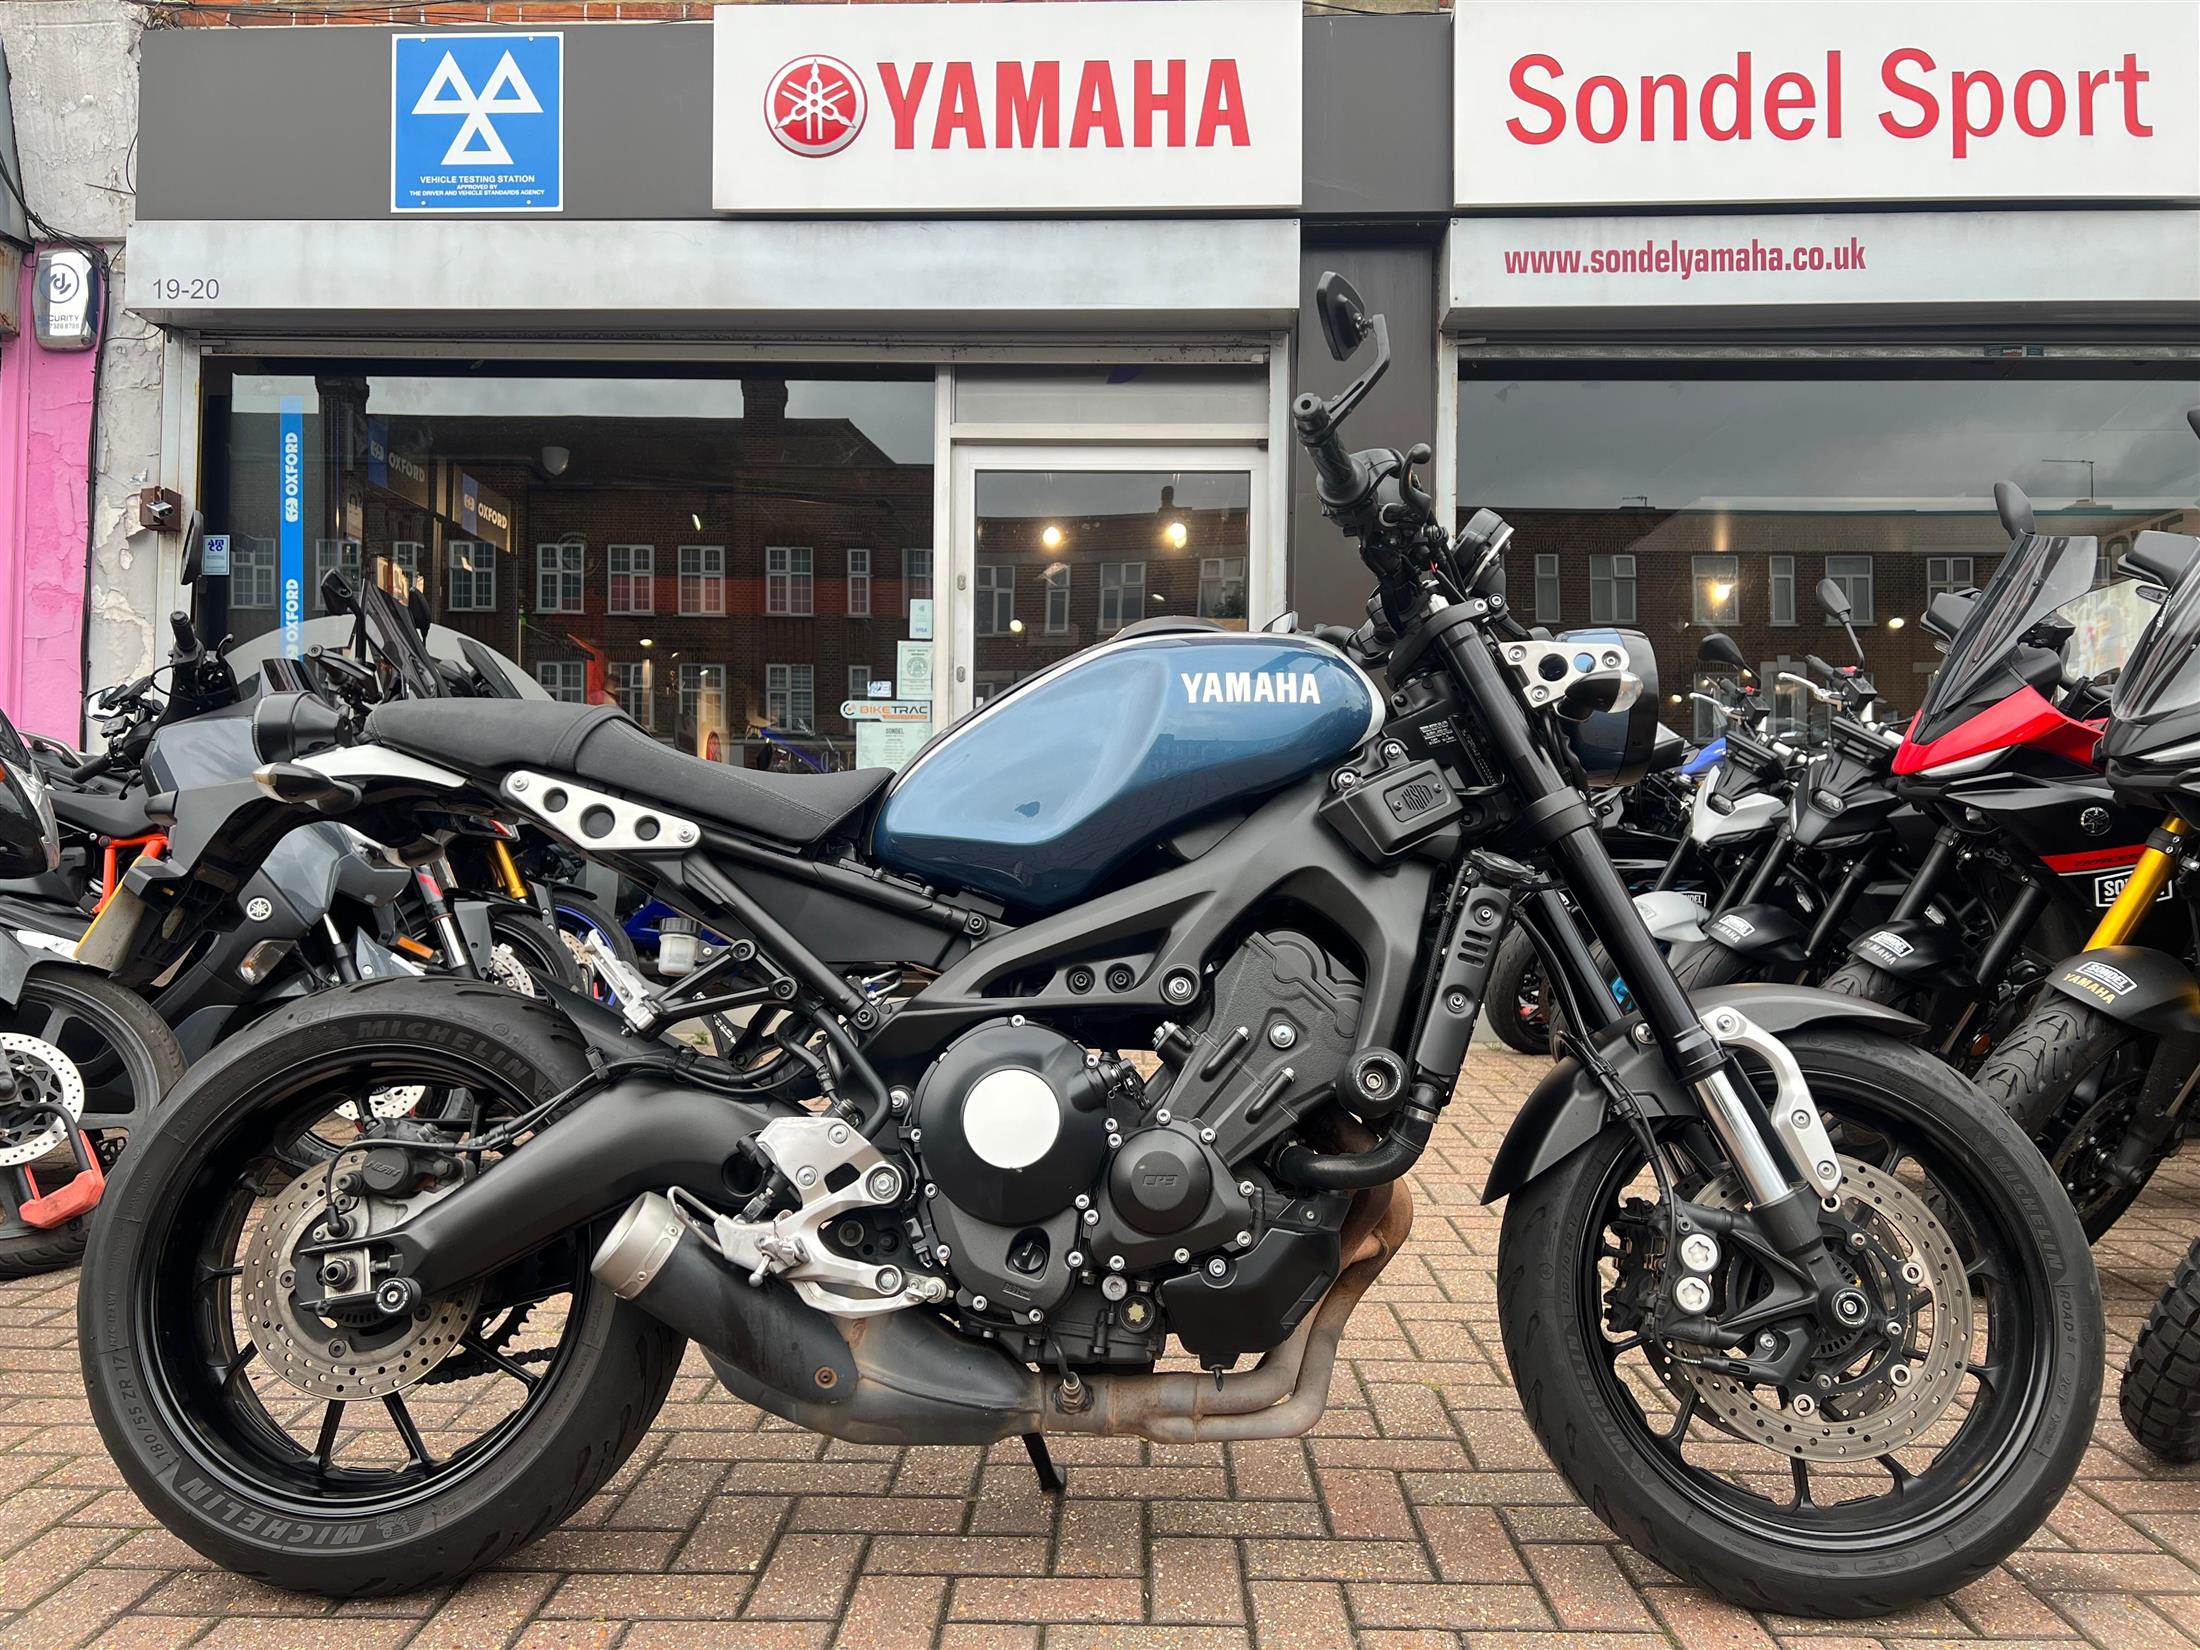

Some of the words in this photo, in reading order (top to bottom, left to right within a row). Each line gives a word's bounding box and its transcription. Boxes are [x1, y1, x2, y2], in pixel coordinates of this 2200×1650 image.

[877, 59, 1251, 150] YAMAHA
[1506, 50, 1842, 145] Sondel
[1878, 47, 2153, 159] Sport
[419, 176, 456, 184] VEHICLE
[458, 175, 495, 183] TESTING
[497, 175, 535, 183] STATION
[1504, 237, 1866, 280] www.sondelyamaha.co.uk
[153, 278, 220, 300] 19-20
[285, 432, 299, 496] OXFORD
[388, 451, 426, 483] OXFORD
[477, 502, 508, 530] OXFORD
[286, 578, 299, 642] OXFORD
[1181, 672, 1321, 705] YAMAHA
[1711, 922, 1742, 944] YAMAHA
[1860, 940, 1898, 966] YAMAHA
[2063, 973, 2116, 1005] YAMAHA
[2086, 963, 2129, 989] SONDEL
[356, 1020, 530, 1080] MICHELIN
[1991, 1152, 2064, 1272] MICHELIN
[2060, 1289, 2074, 1333] ROAD
[112, 1355, 128, 1372] 17
[119, 1379, 137, 1401] ZR
[1565, 1334, 1628, 1452] MICHELIN
[128, 1406, 169, 1461] 180/55
[179, 1476, 368, 1546] MICHELIN
